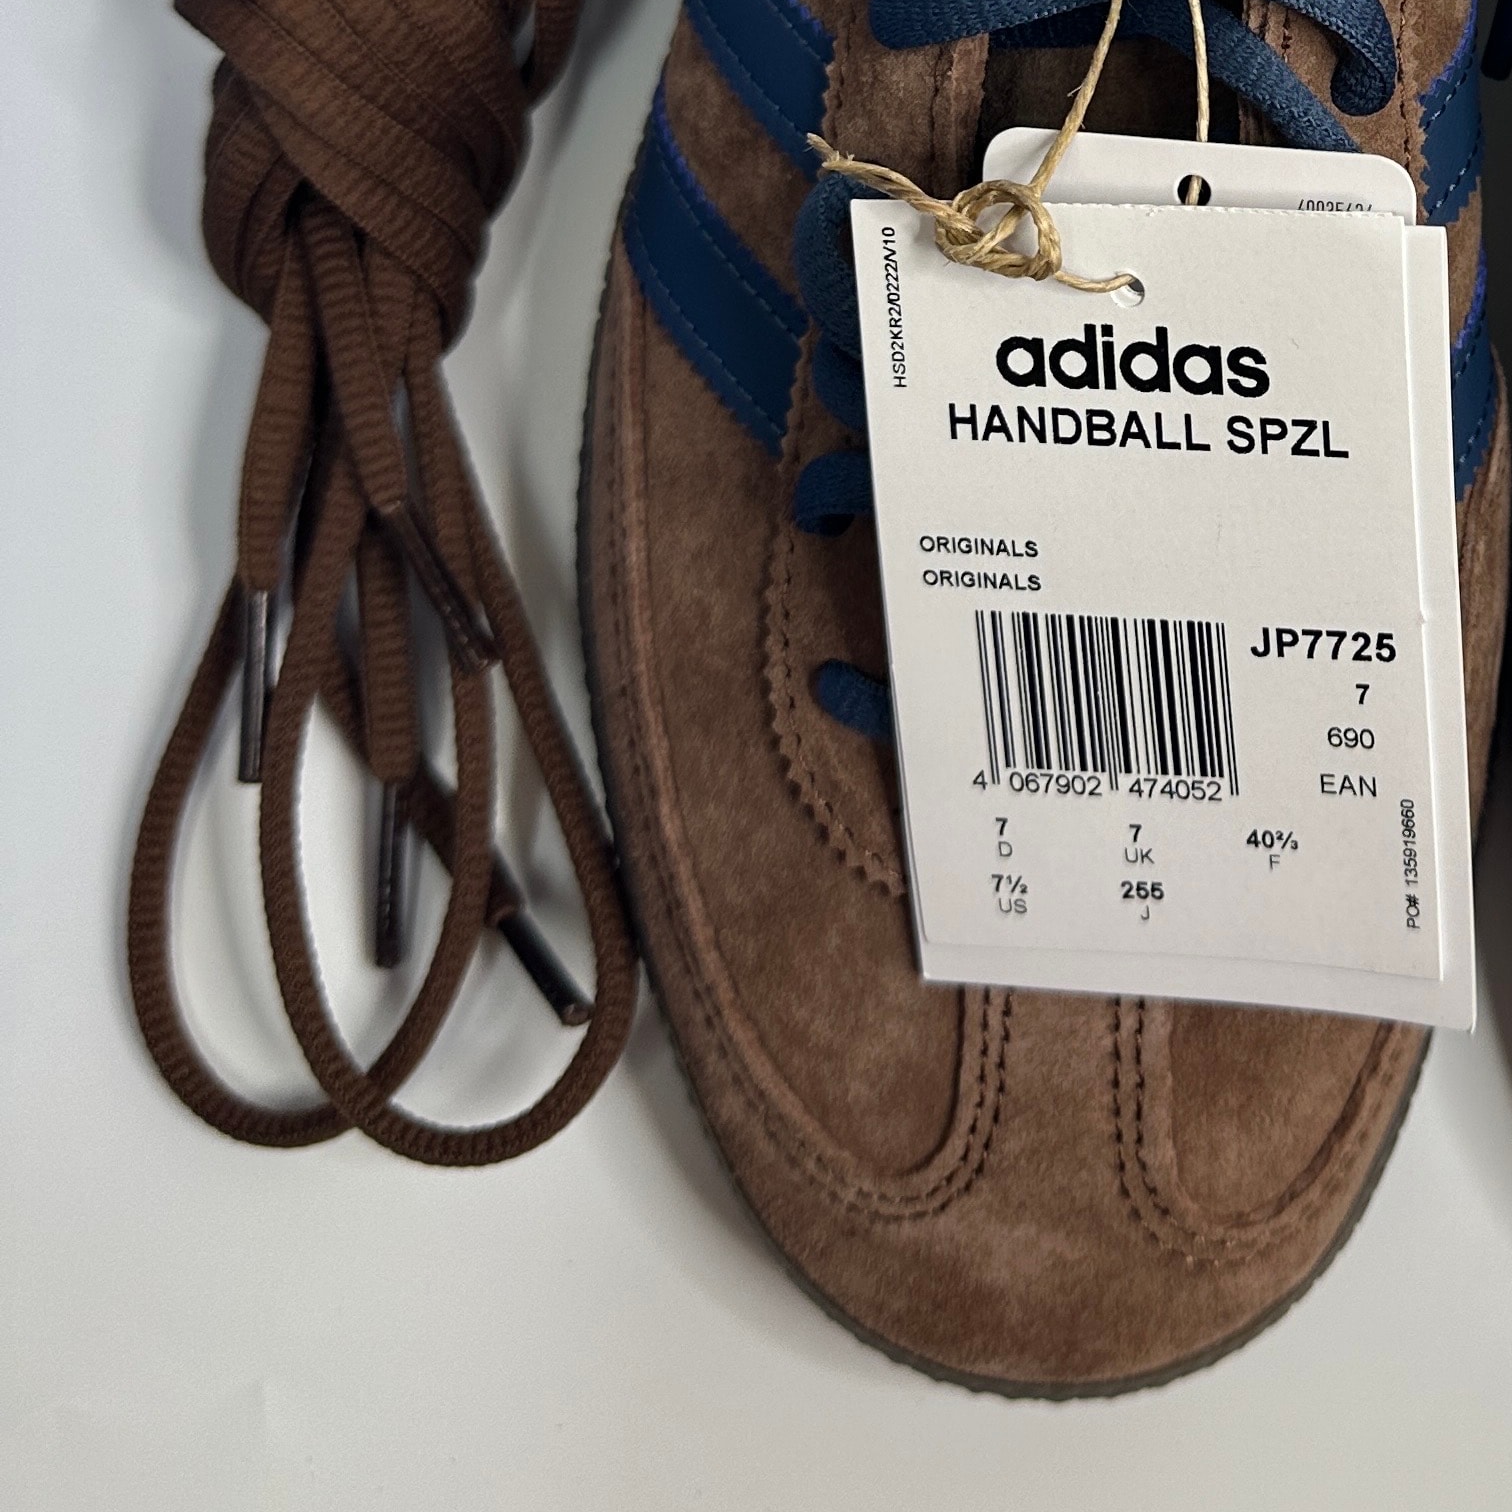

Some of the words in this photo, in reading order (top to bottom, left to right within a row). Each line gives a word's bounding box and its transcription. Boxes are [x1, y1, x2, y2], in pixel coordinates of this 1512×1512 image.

[995, 323, 1271, 398] adidas
[948, 403, 1211, 453] HANDBALL
[1226, 414, 1350, 459] SPZL
[919, 535, 1039, 558] ORIGINALS
[922, 569, 1042, 592] ORIGINALS
[1250, 626, 1397, 663] JP7725
[1355, 683, 1370, 705] 7
[1326, 726, 1375, 750] 690
[972, 769, 989, 791] 4
[1008, 770, 1103, 797] 067902
[1128, 776, 1223, 802] 474052
[1319, 773, 1378, 798] EAN
[995, 816, 1009, 836] 7
[1128, 823, 1143, 843] 7
[997, 840, 1014, 858] D
[1400, 798, 1418, 886] 135919660
[1124, 847, 1156, 865] UK
[1268, 853, 1282, 871] F
[1120, 880, 1165, 901] 255
[998, 897, 1029, 914] US
[1140, 904, 1152, 921] J
[1405, 892, 1421, 929] PO#
